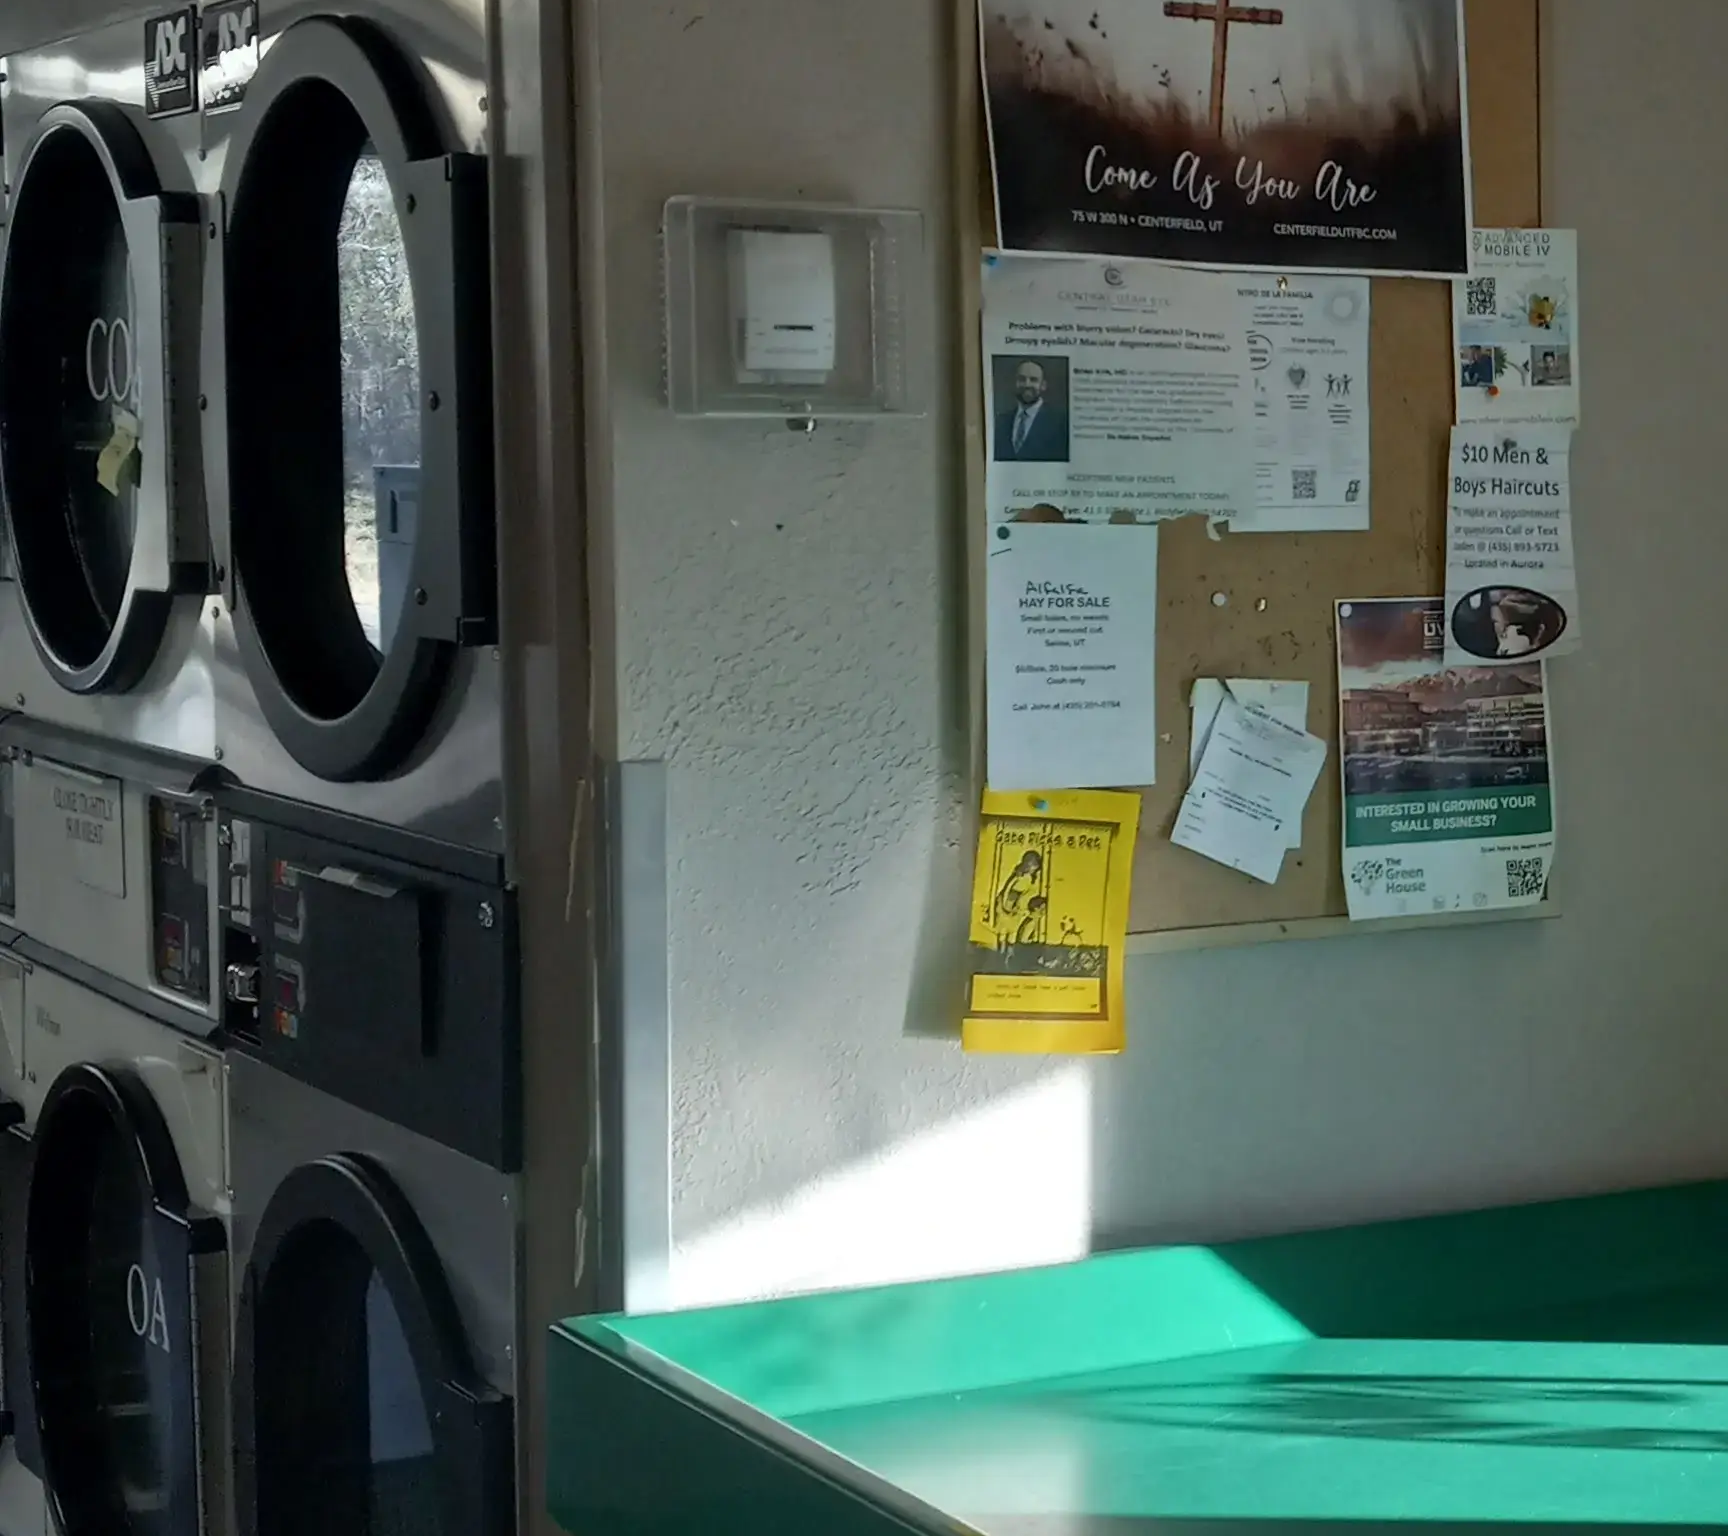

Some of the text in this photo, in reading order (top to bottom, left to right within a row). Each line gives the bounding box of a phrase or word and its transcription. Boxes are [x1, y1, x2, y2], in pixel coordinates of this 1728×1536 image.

[1084, 143, 1378, 213] Come As You Are
[1208, 219, 1224, 233] UT
[1273, 222, 1398, 241] CENTERFIELDUTFBC.COM
[1484, 231, 1551, 244] ADVANCED
[1484, 244, 1551, 257] MOBILE IV
[1461, 442, 1550, 466] $10 Men &
[1454, 476, 1560, 498] Boys Haircuts
[1505, 525, 1522, 536] Call
[1524, 527, 1535, 536] or
[1537, 525, 1558, 536] Text
[1018, 596, 1110, 609] HAY FOR SALE
[1355, 795, 1537, 819] INTERESTED IN GROWING YOUR
[1390, 814, 1498, 833] SMALL BUSINESS?
[1385, 857, 1402, 867] The
[1385, 867, 1424, 881] Green
[1385, 882, 1427, 894] House
